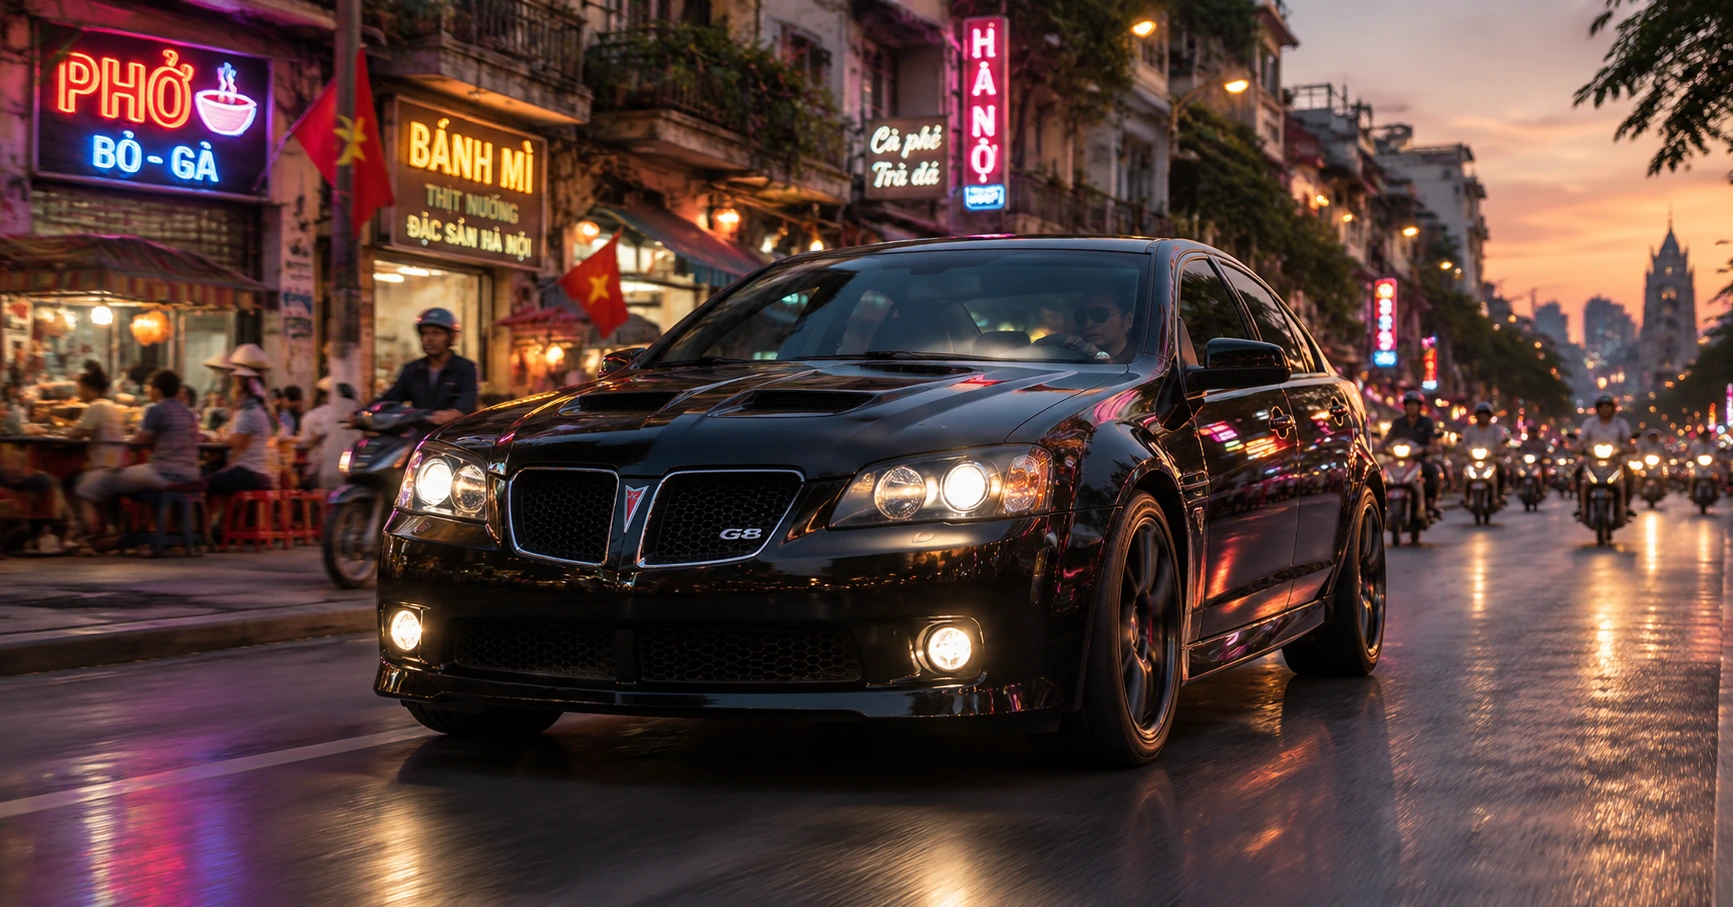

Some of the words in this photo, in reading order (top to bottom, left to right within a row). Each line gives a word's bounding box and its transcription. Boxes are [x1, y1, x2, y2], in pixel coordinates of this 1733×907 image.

[58, 49, 195, 129] PHỞ
[500, 140, 534, 194] MÌ
[719, 528, 762, 540] G8
